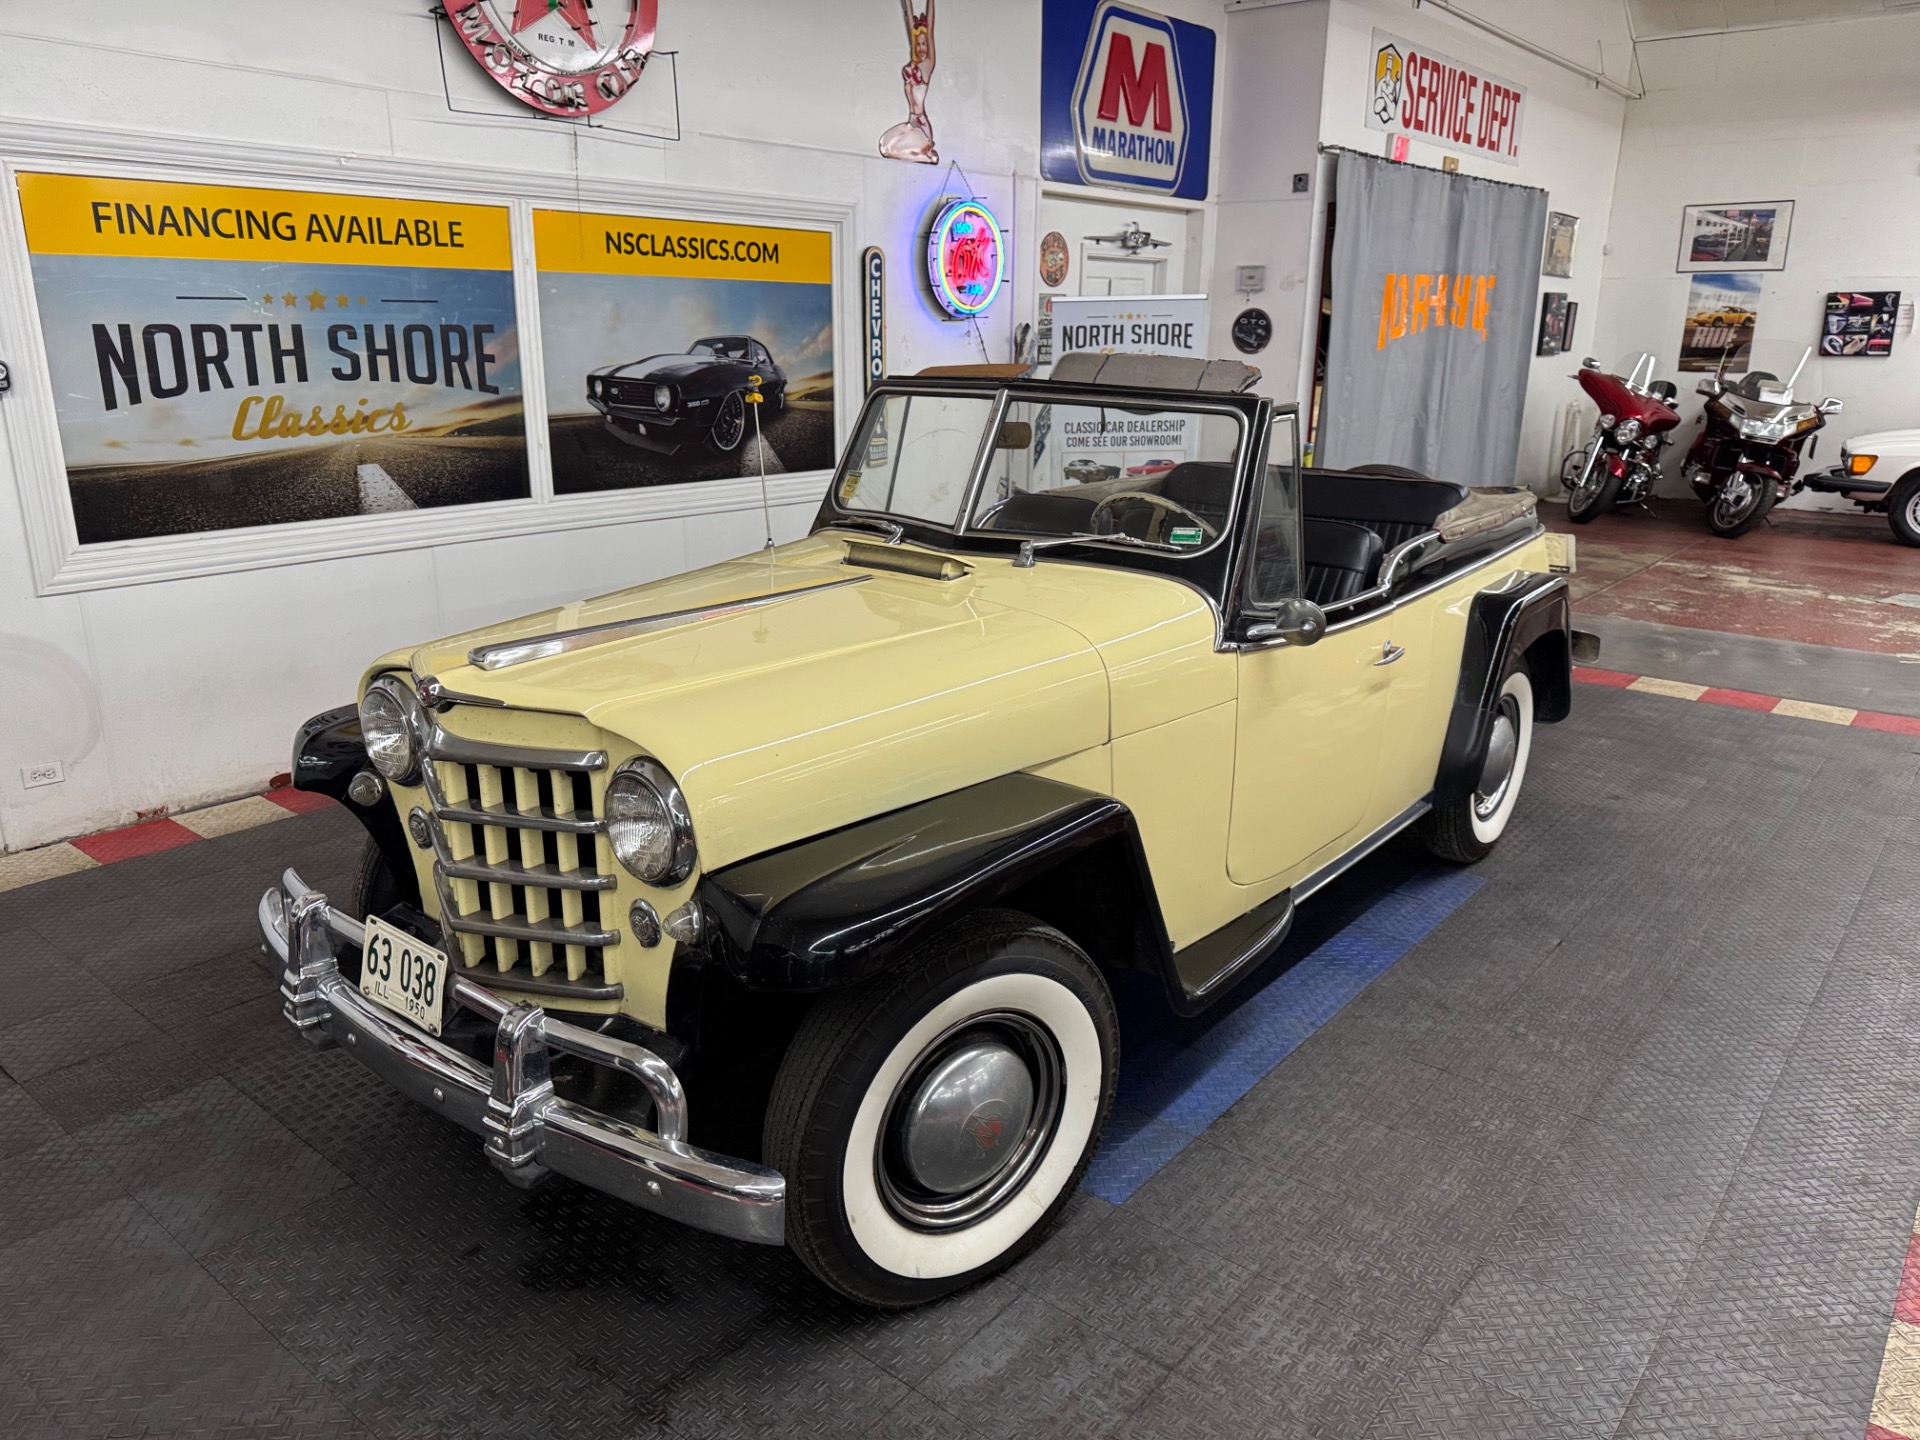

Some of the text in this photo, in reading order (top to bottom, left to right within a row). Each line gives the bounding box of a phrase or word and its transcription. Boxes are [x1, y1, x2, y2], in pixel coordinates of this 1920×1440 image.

[454, 2, 589, 113] MOTOR
[1097, 32, 1172, 133] M
[1401, 51, 1521, 158] SERVICE DEPT.
[1092, 126, 1175, 166] MARATHON
[91, 201, 465, 249] FINANCING AVAILABLE
[605, 230, 780, 264] NSCLASSICS.COM
[1062, 323, 1125, 352] NORTH
[1131, 322, 1194, 350] SHORE
[1239, 317, 1268, 326] GTO
[91, 323, 500, 412] NORTH SHORE
[231, 394, 413, 442] Classics
[1064, 419, 1186, 435] CLASSIC CAR DEALERSHIP
[1066, 434, 1182, 448] COME SEE OUR SHOWROOM!
[367, 933, 436, 1008] 63 038
[374, 980, 425, 1020] ILL 1950
